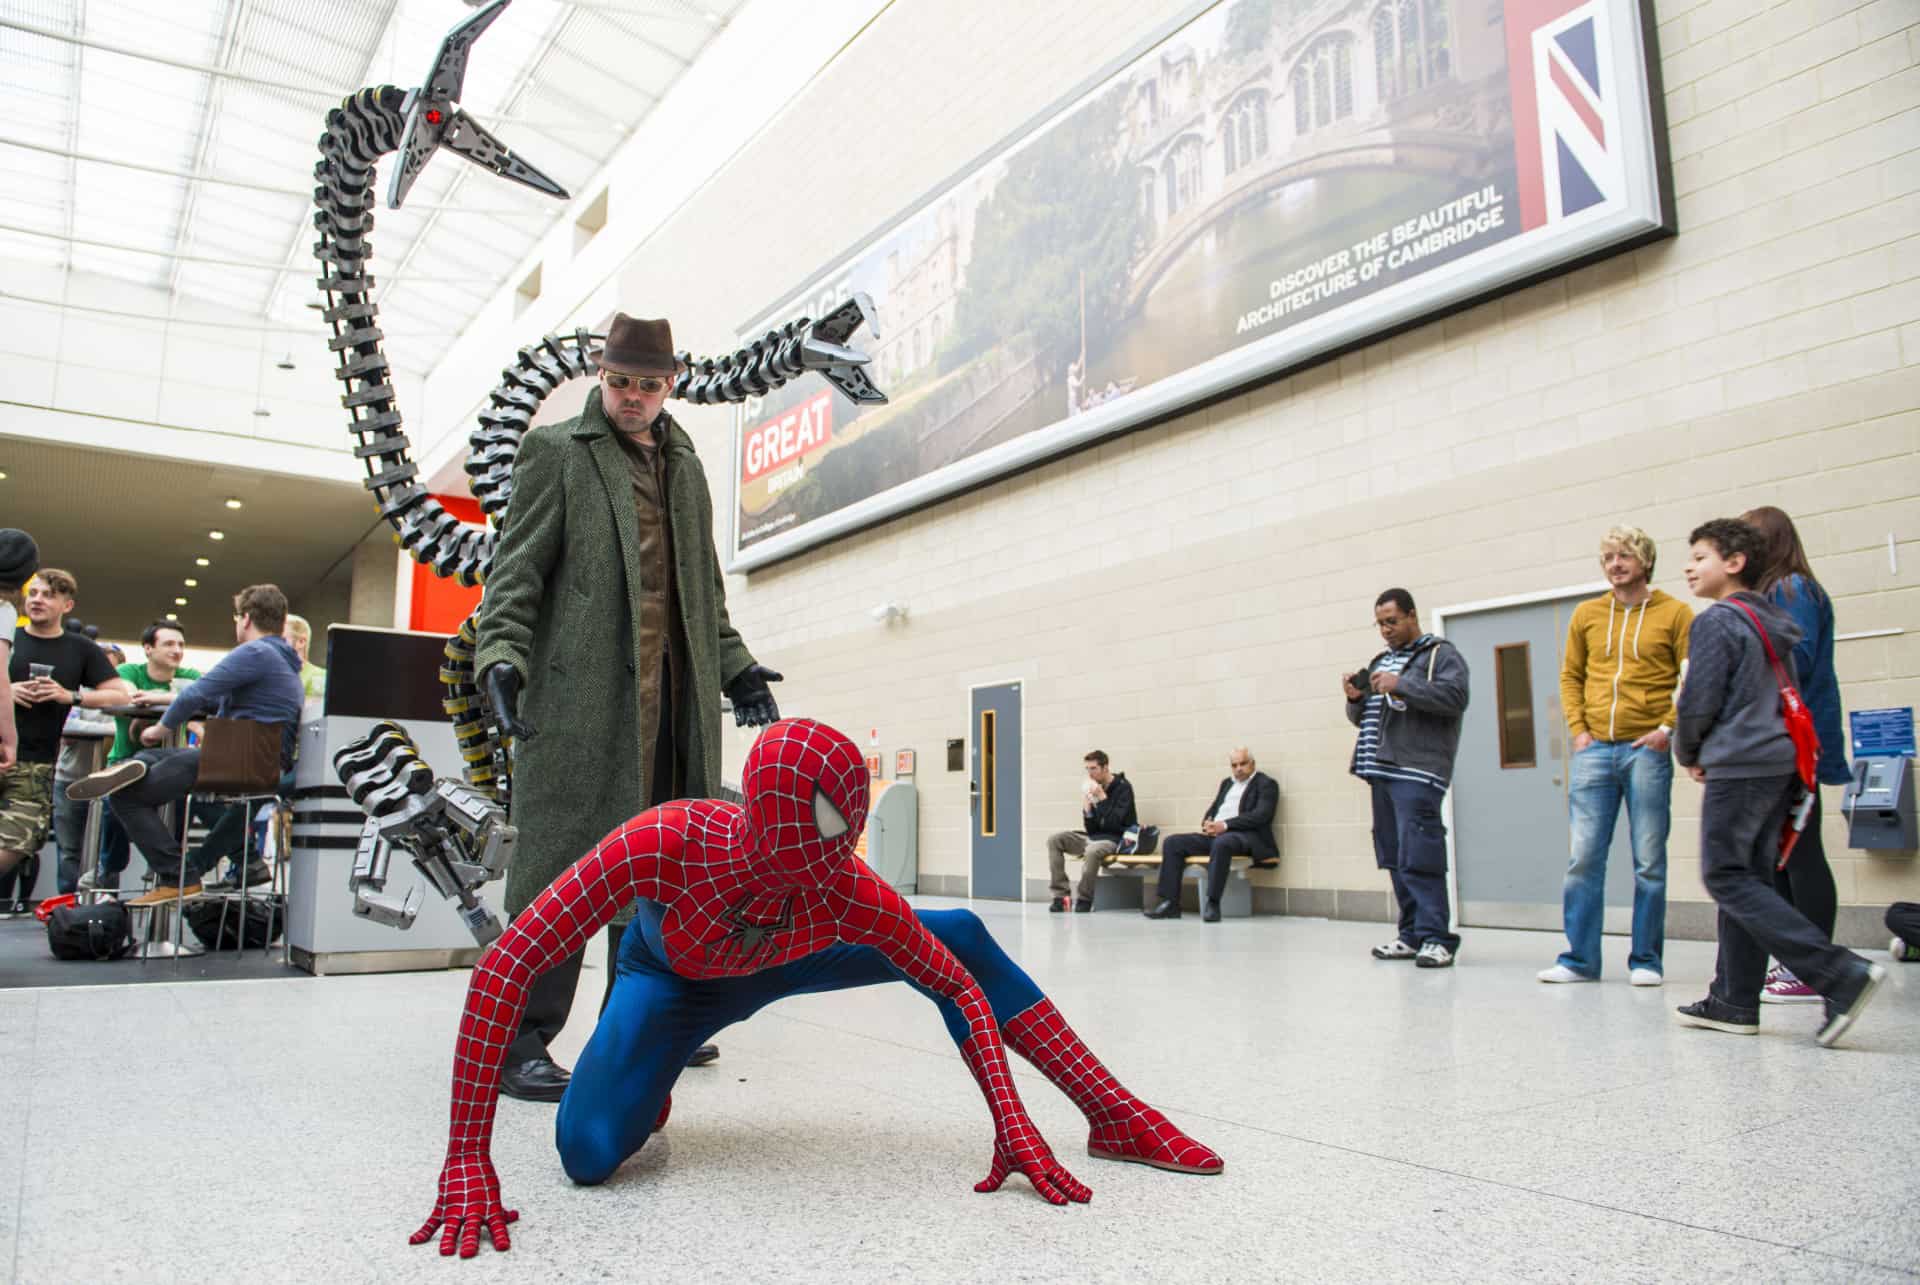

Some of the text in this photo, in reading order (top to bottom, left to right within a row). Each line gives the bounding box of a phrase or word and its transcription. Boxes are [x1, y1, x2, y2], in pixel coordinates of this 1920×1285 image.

[1236, 206, 1505, 334] ARCHITECTURE OF CAMBRIDGE
[1270, 184, 1503, 298] DISCOVER THE BEAUTIFUL
[746, 395, 829, 475] GREAT
